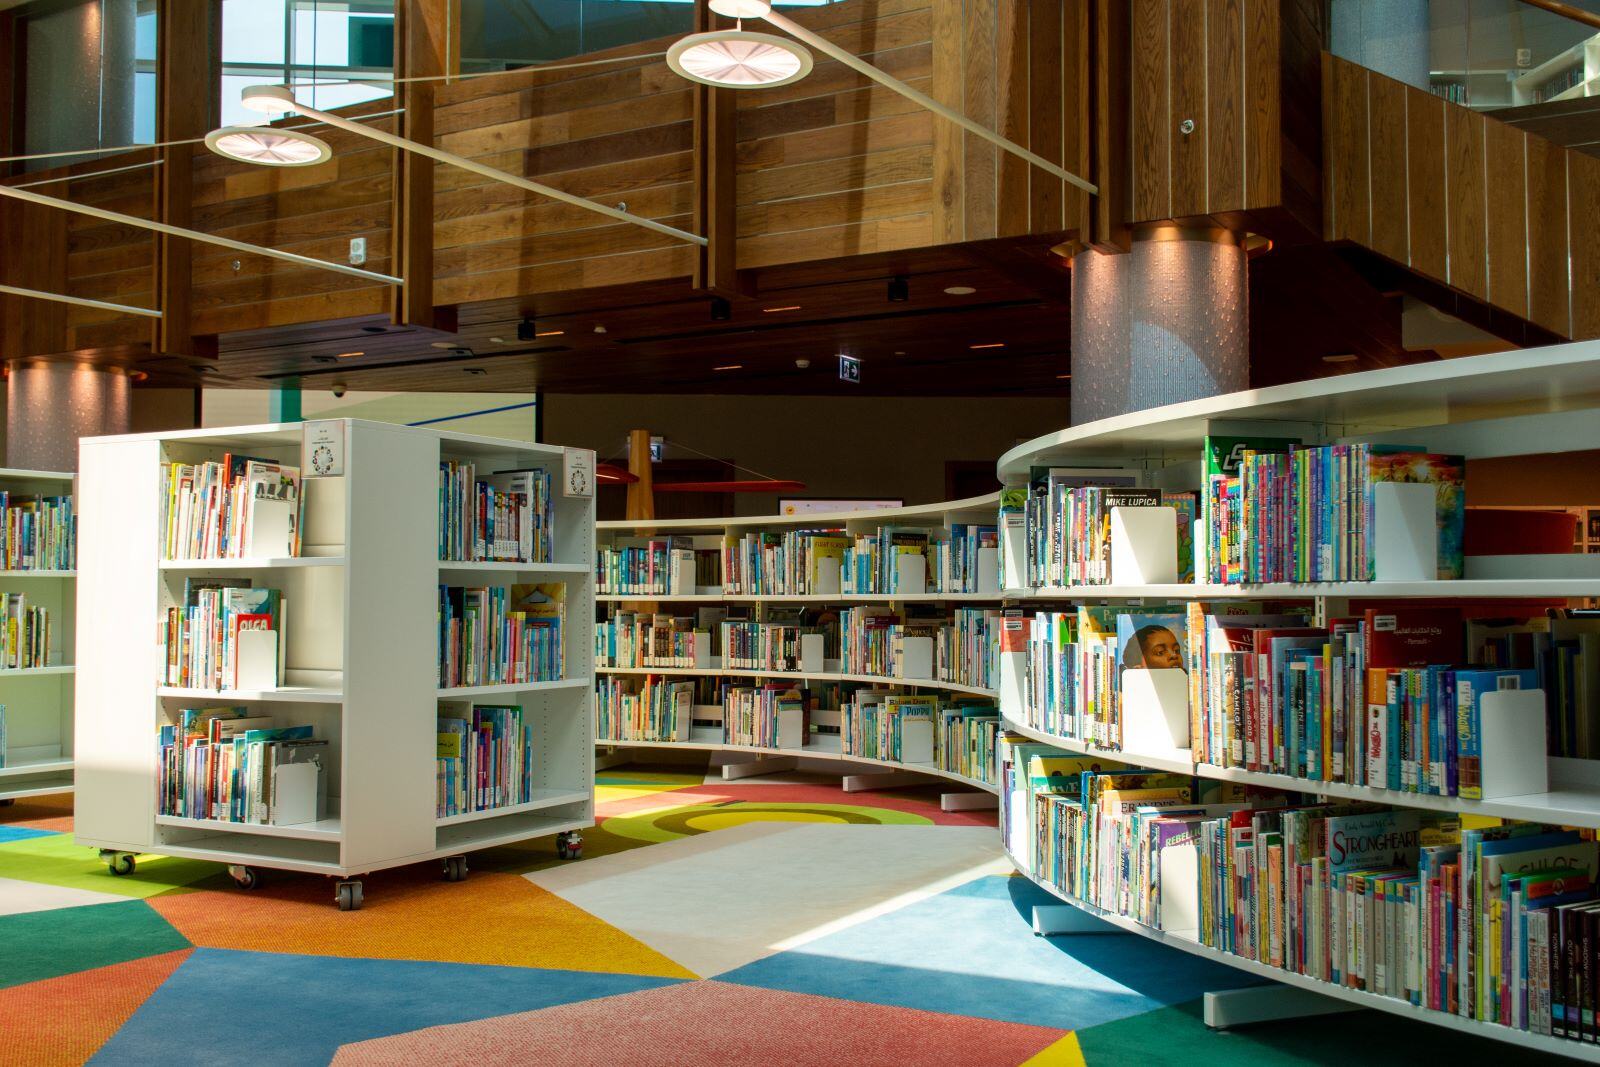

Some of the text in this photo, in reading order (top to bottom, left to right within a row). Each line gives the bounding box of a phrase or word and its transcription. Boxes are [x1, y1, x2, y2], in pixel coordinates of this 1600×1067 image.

[1105, 497, 1126, 507] MIKE
[1128, 497, 1157, 507] LUPICA
[1330, 830, 1419, 865] STRONGHEART
